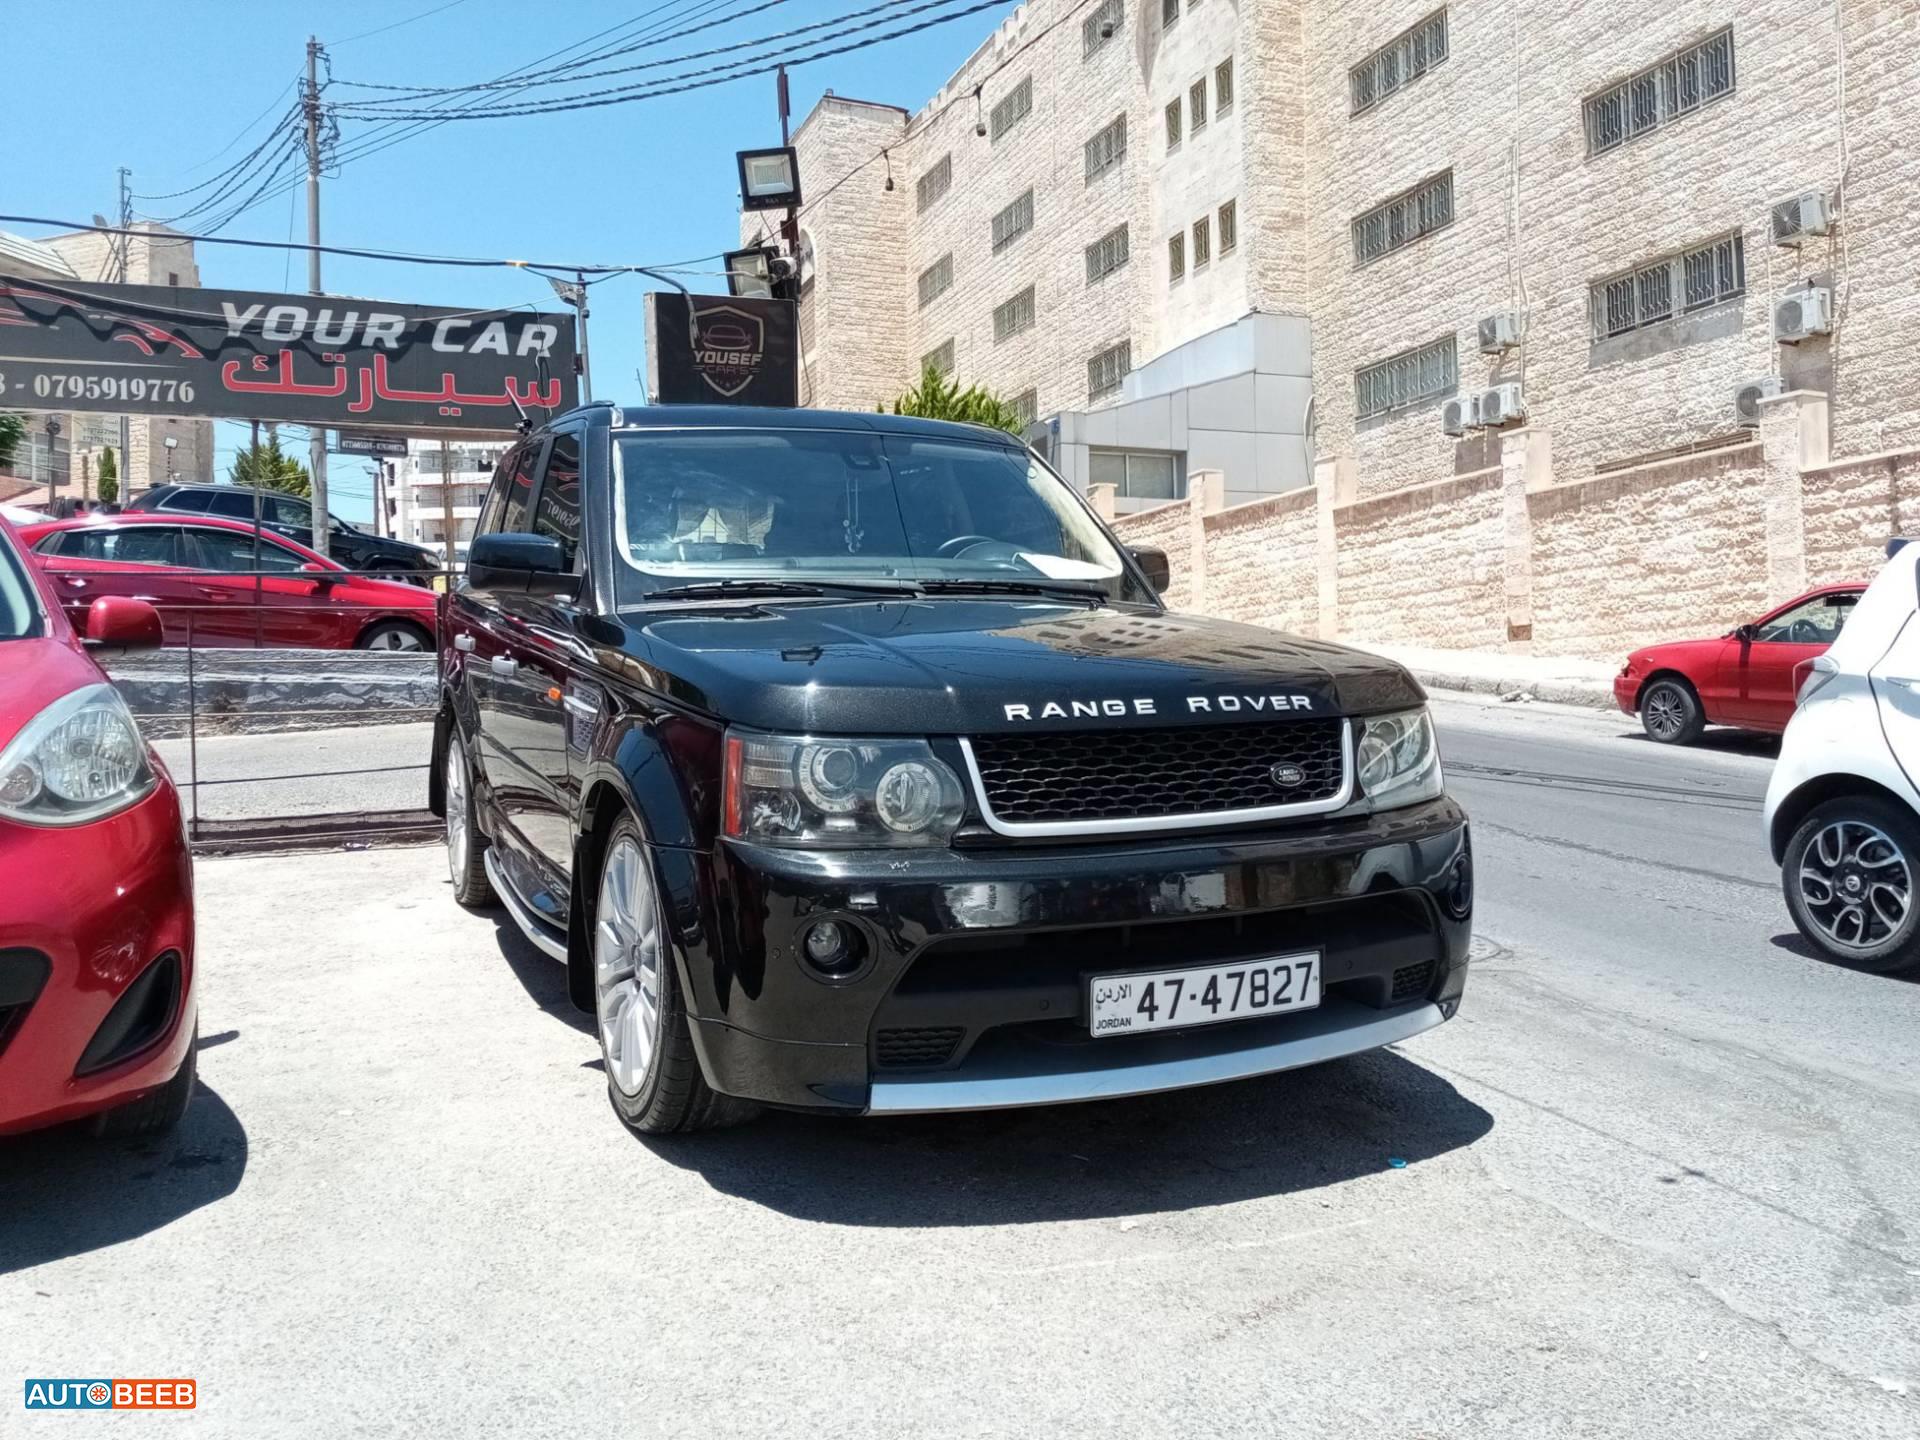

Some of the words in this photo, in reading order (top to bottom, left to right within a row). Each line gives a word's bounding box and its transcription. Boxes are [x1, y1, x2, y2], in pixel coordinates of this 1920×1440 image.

[220, 302, 406, 349] YOUR
[431, 318, 558, 358] CAR
[693, 350, 763, 366] YOUSEF
[33, 374, 195, 403] 0795919776
[221, 348, 562, 416] سيارتك
[1003, 698, 1157, 721] RANGE
[1186, 695, 1313, 713] ROVER
[1095, 1017, 1132, 1030] JORDAN
